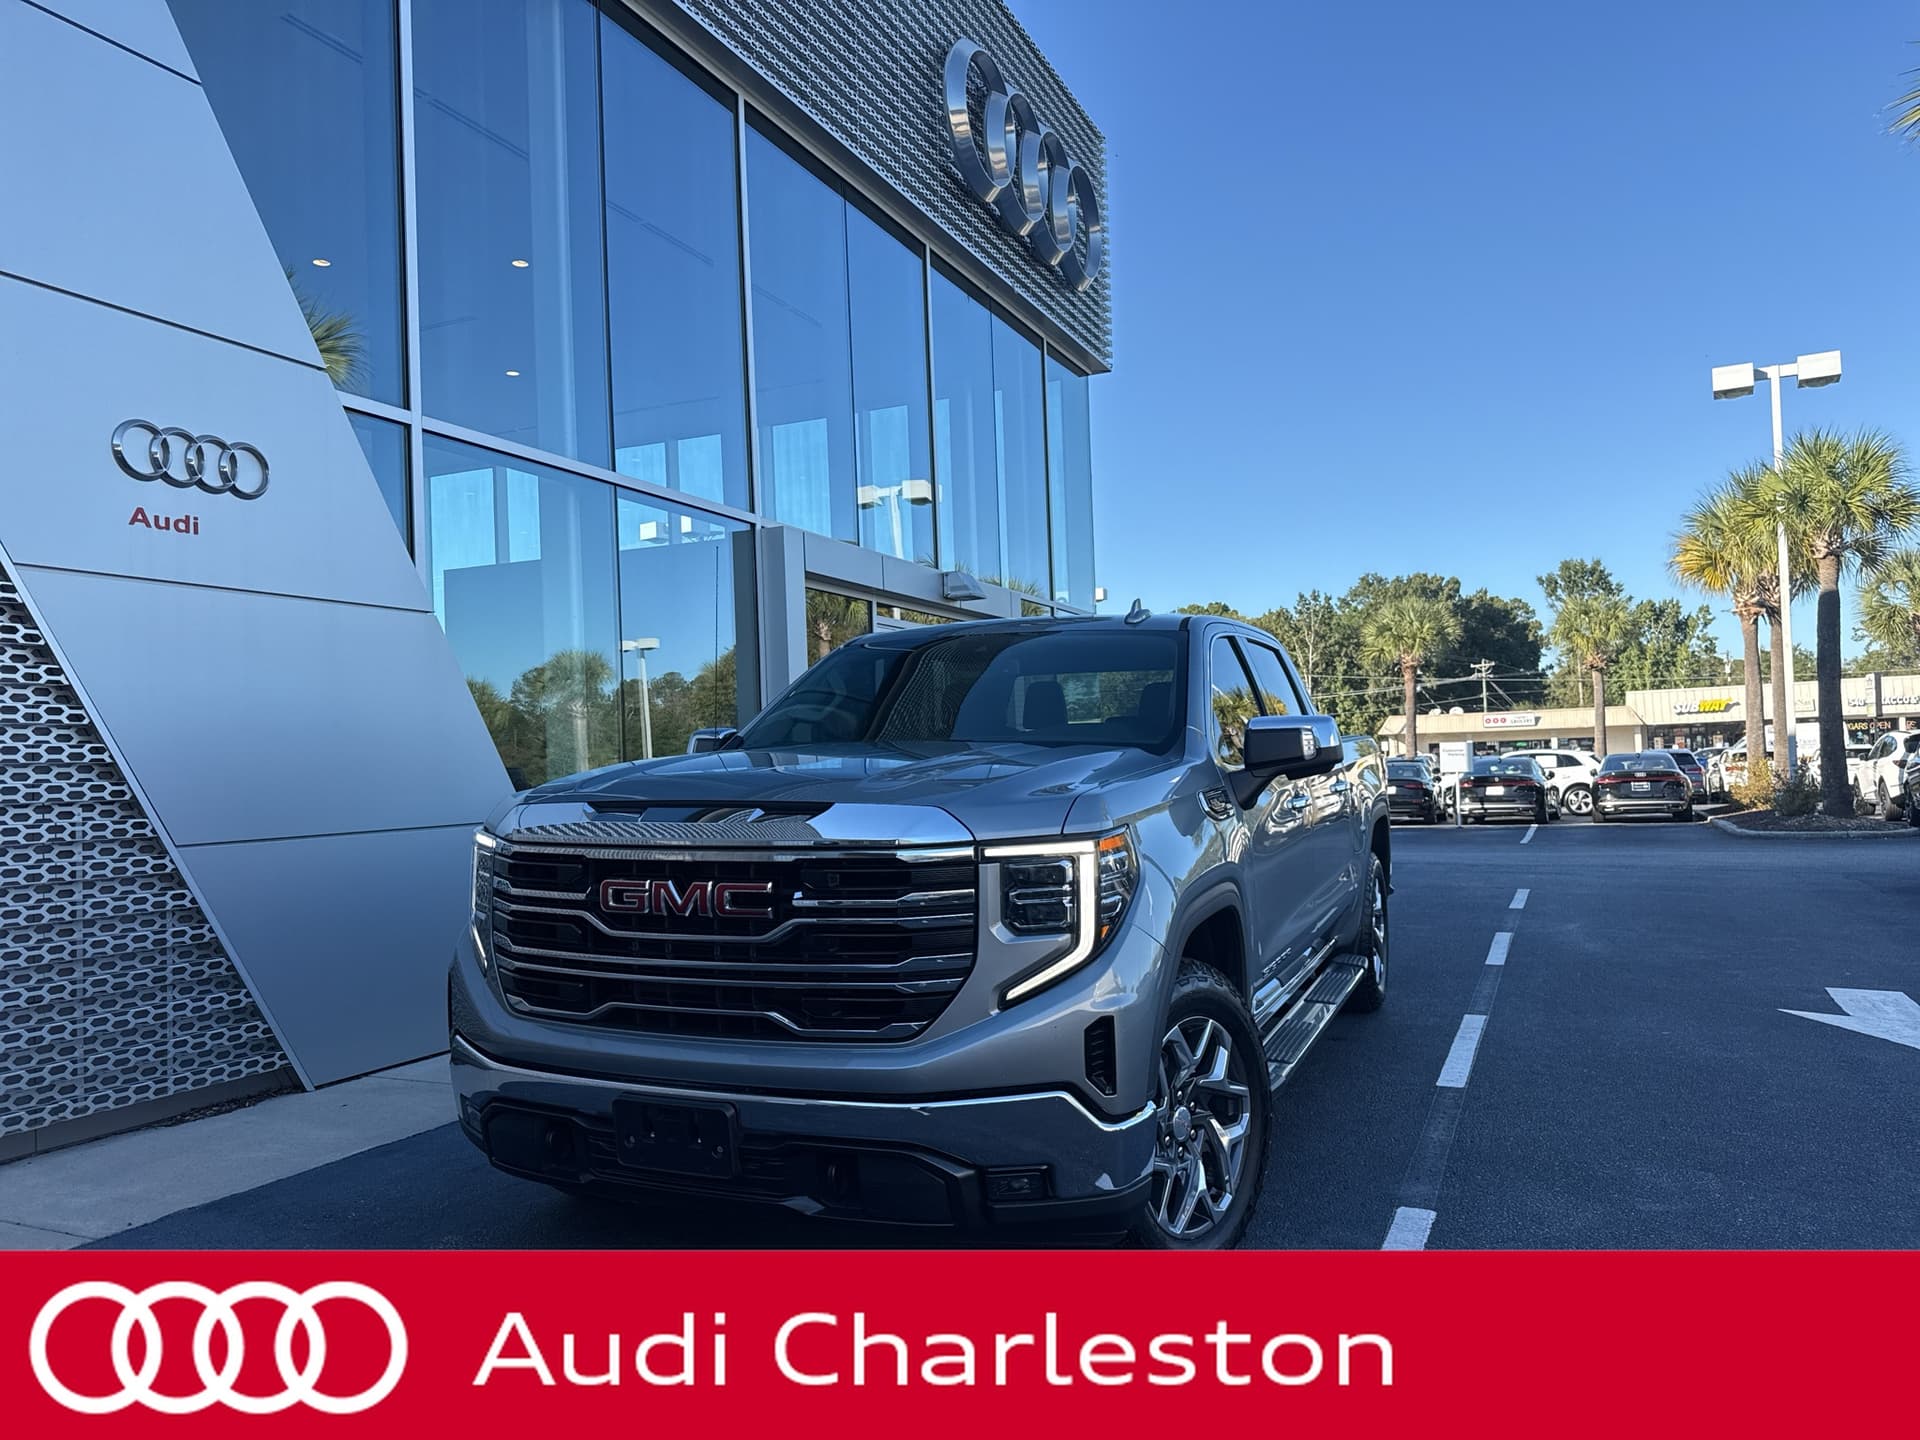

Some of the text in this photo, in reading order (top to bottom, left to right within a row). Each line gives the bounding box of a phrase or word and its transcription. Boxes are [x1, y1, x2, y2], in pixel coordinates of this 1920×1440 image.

[129, 507, 199, 535] Audi
[1674, 697, 1734, 713] SUBWAY
[599, 879, 774, 919] GMC
